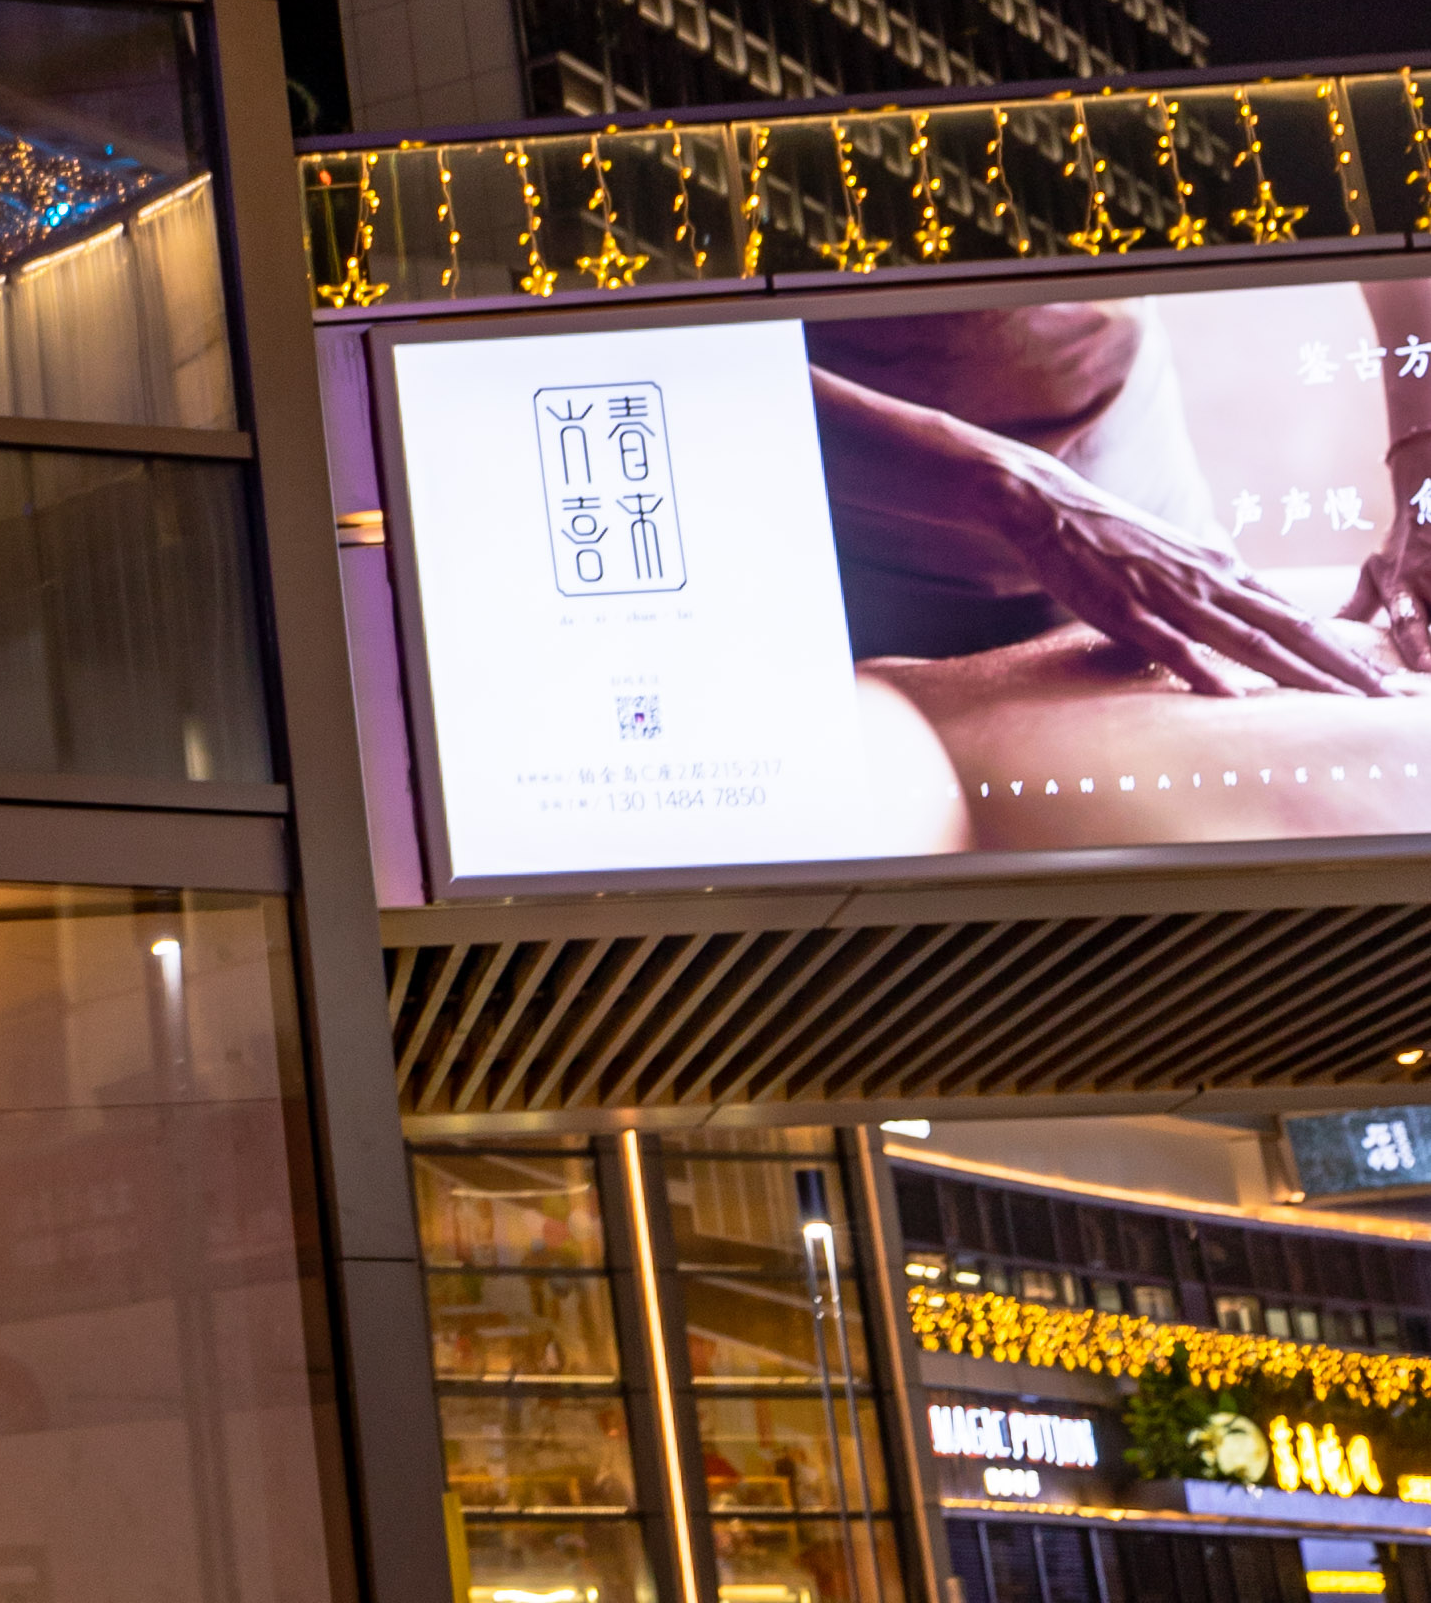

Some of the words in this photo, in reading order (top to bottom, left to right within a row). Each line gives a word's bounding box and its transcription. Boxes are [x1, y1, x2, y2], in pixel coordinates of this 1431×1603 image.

[1231, 486, 1376, 539] 声声慢
[608, 791, 646, 813] 130
[656, 788, 706, 810] 1484
[714, 785, 767, 807] 7850
[929, 1405, 1012, 1459] MAGIC
